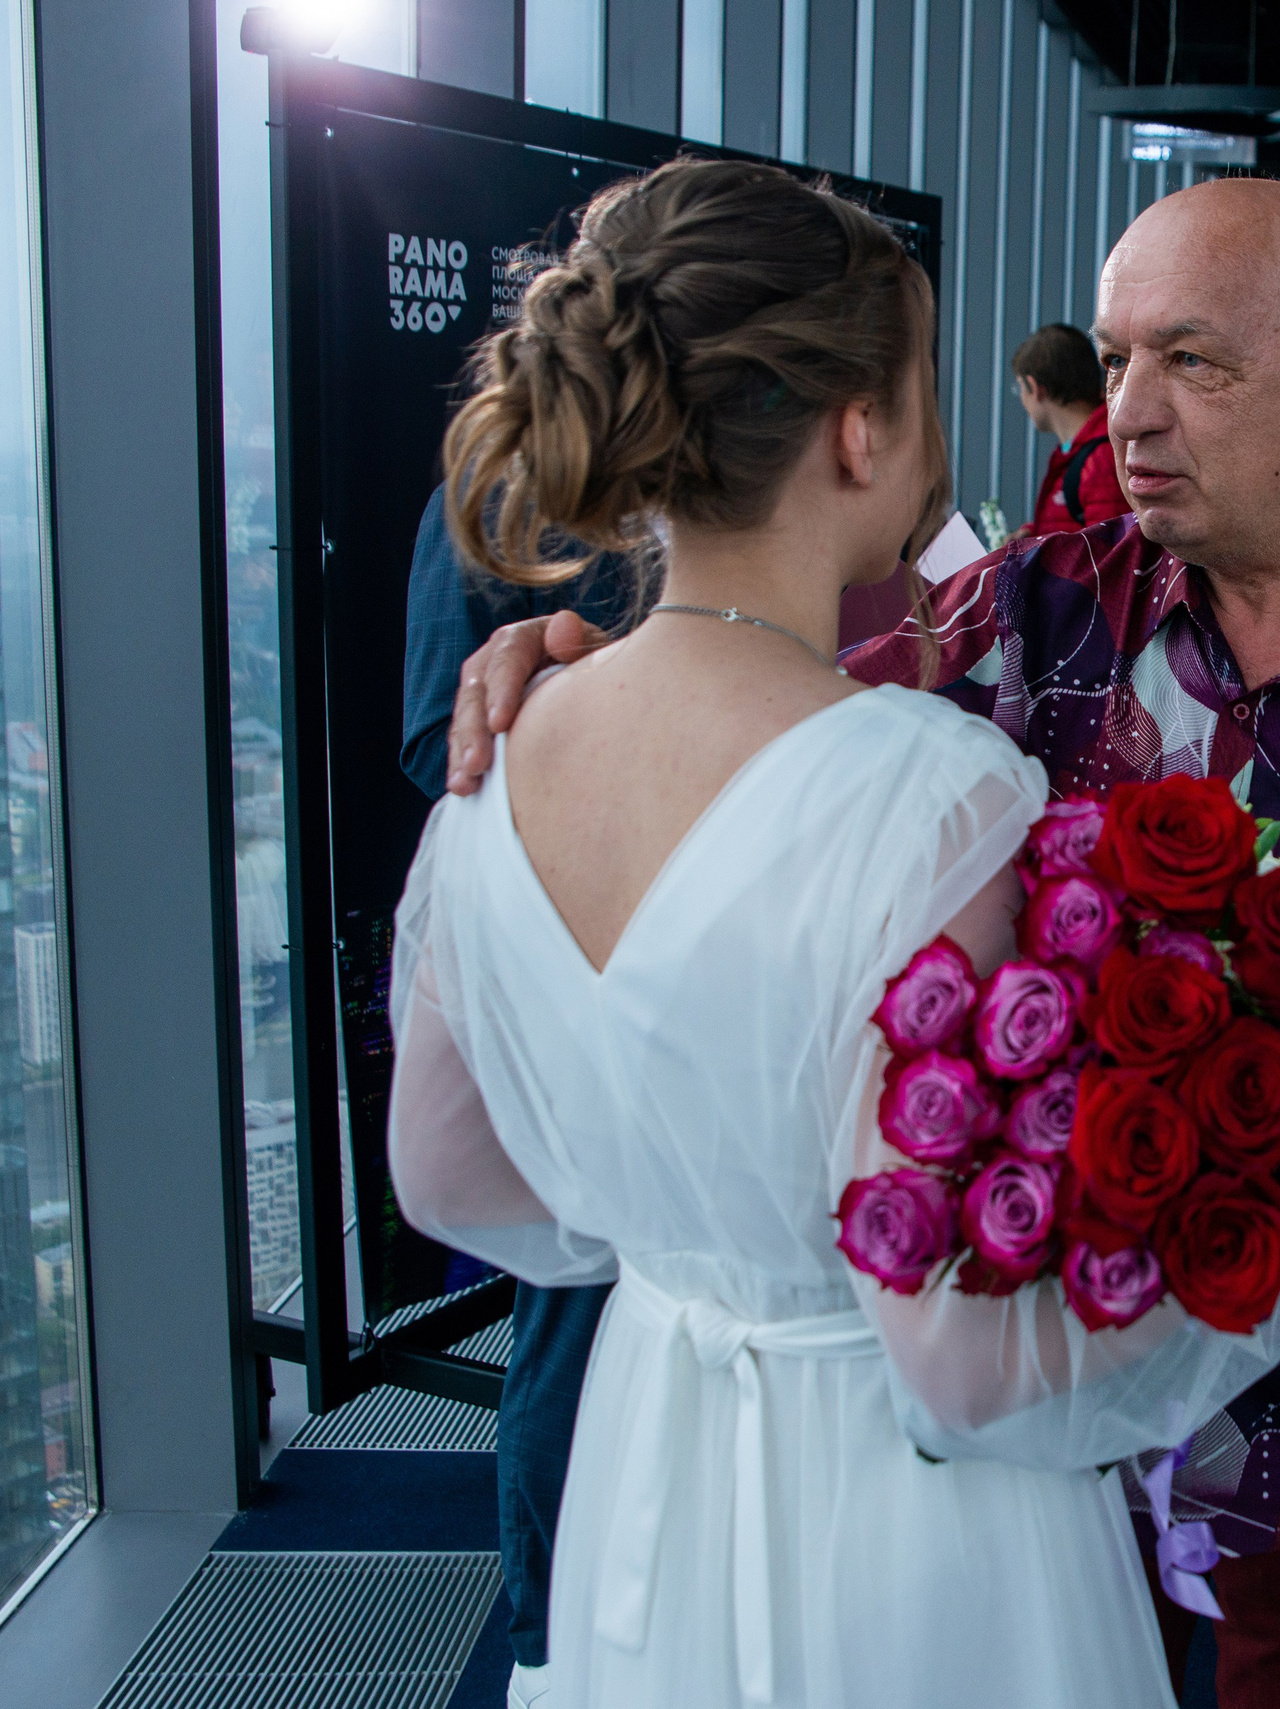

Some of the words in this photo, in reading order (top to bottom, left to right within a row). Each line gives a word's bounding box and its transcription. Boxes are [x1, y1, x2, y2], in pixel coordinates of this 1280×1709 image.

[388, 233, 468, 270] PANO
[388, 265, 467, 301] RAMA
[492, 265, 535, 283] ПЛОЩА
[390, 299, 446, 333] 360
